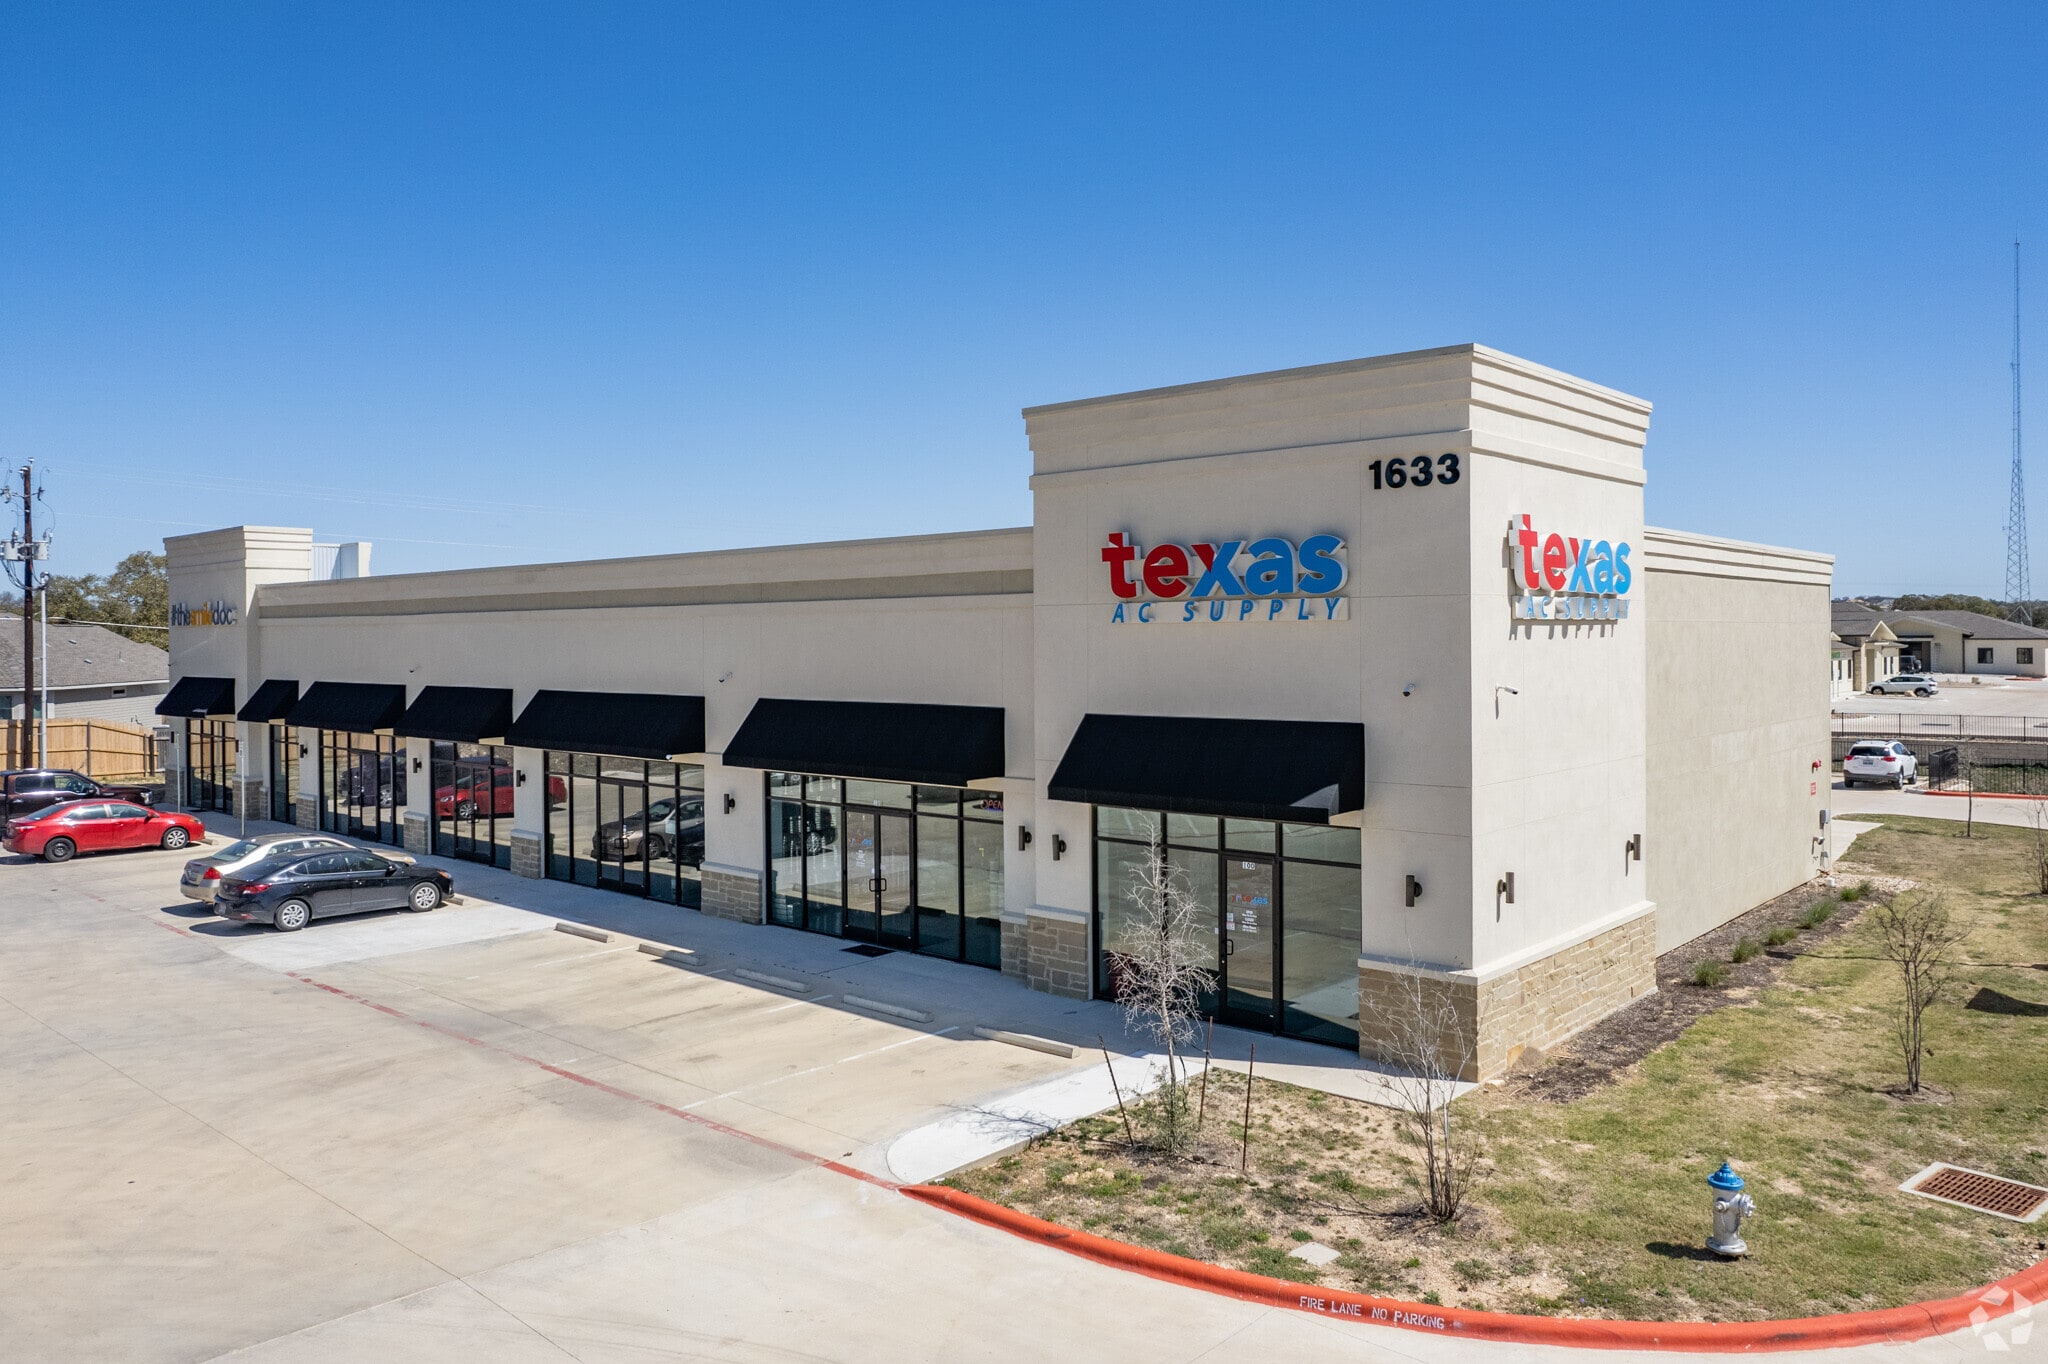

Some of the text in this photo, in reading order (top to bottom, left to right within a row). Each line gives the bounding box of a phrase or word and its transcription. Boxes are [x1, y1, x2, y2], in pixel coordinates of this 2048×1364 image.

[1368, 453, 1460, 490] 1633
[1101, 532, 1345, 599] texas
[1518, 513, 1632, 595] texas
[1112, 597, 1341, 624] AC SUPPLY
[1524, 596, 1548, 618] AC
[1299, 1296, 1445, 1330] FIRE LANE NO PARKING
